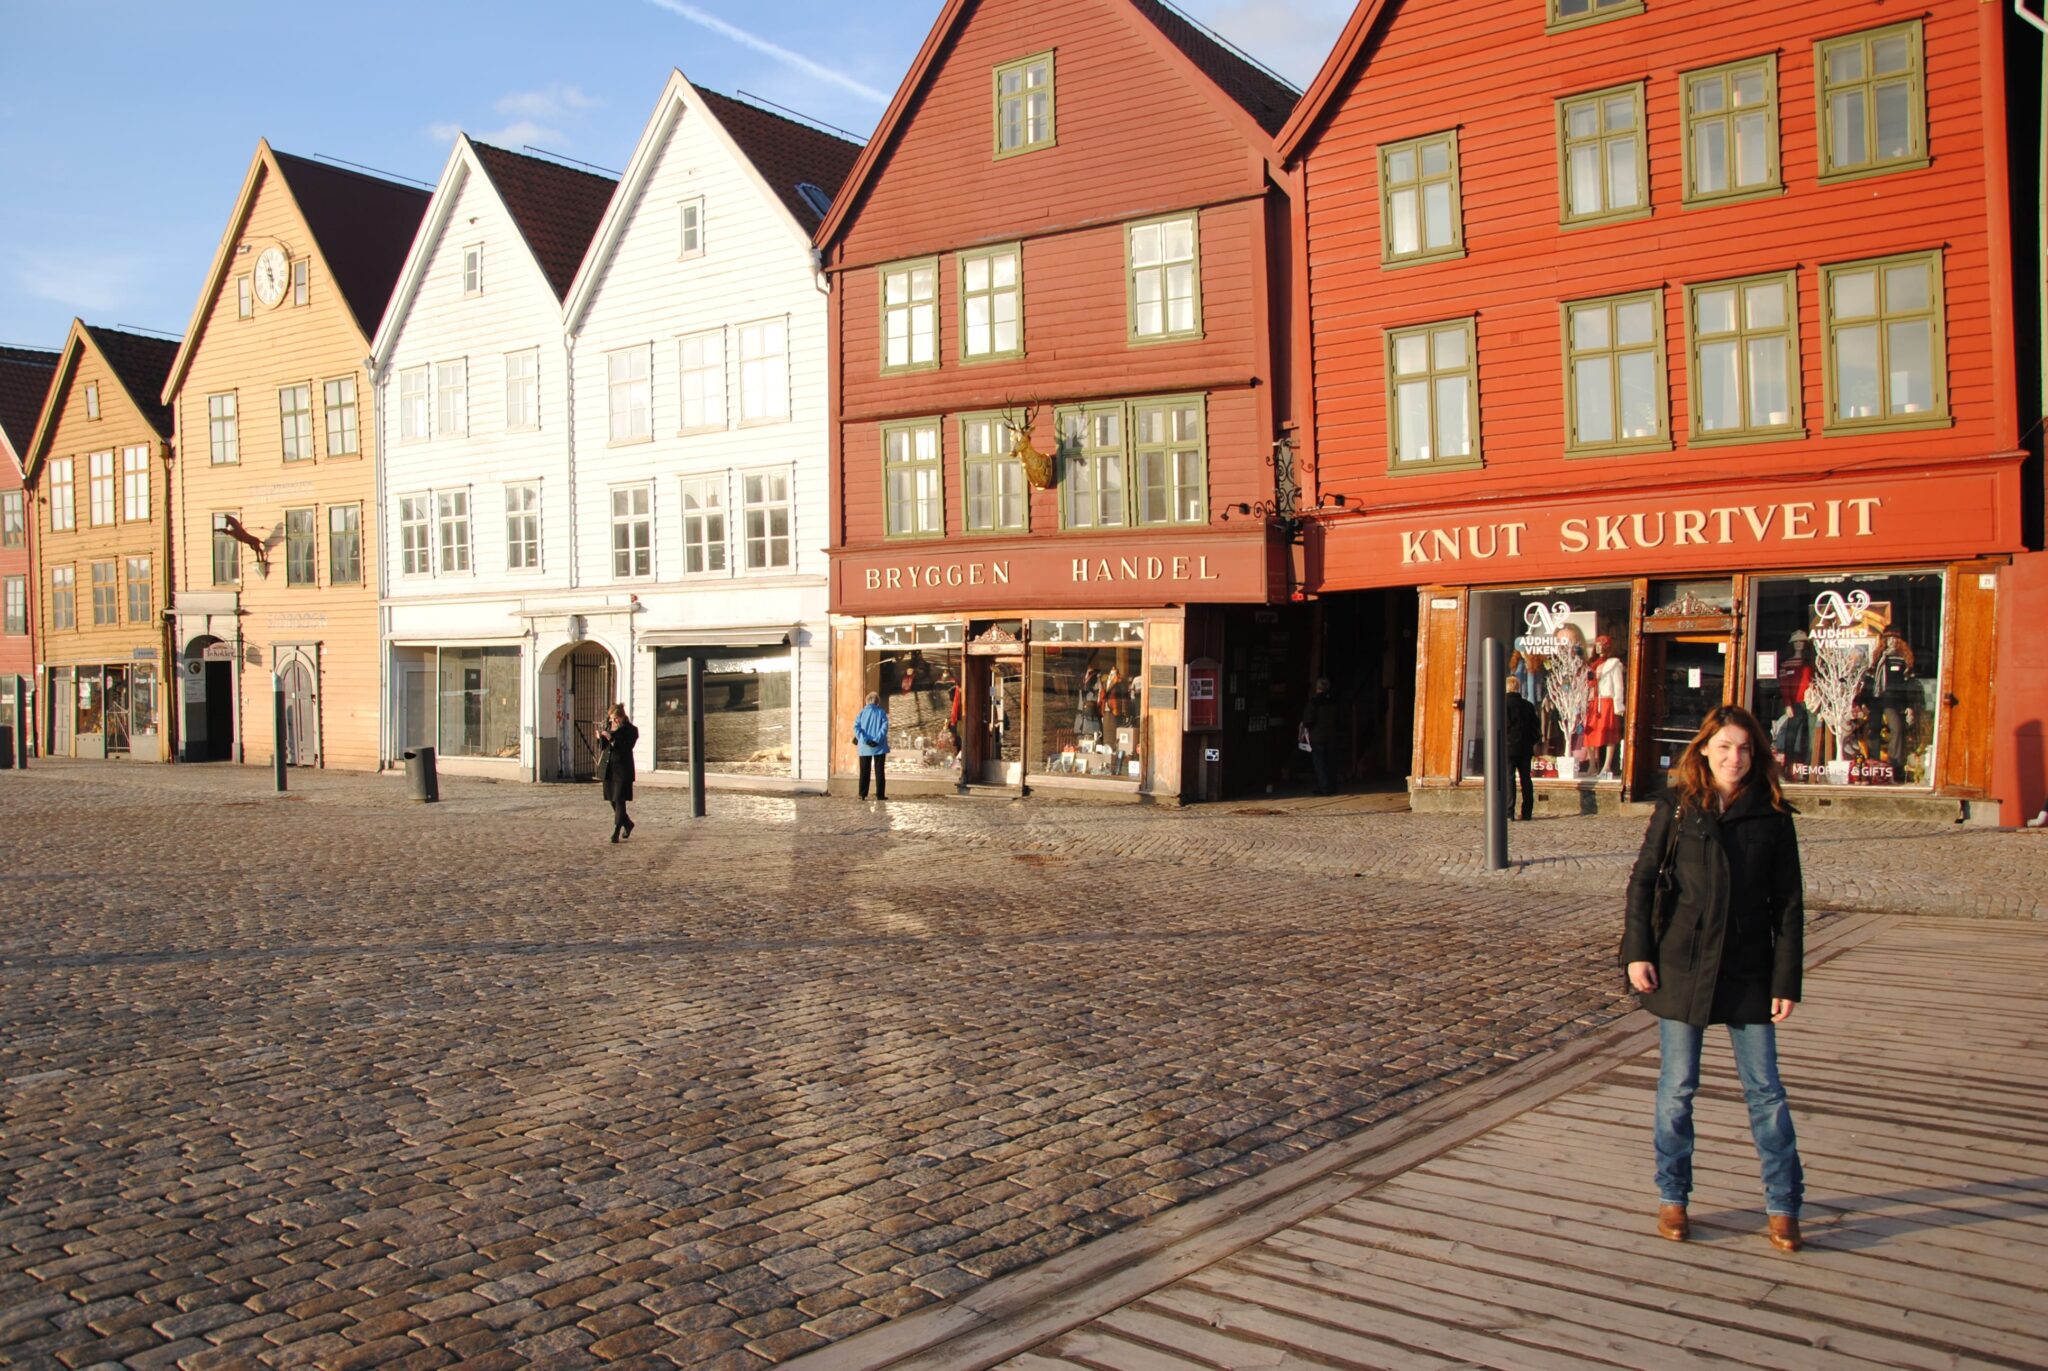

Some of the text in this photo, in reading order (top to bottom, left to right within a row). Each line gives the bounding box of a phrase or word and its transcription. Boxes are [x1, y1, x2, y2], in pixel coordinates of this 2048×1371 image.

[1401, 497, 1881, 565] KNUT SKURTVEIT
[865, 556, 1220, 590] BRYGGEN HANDEL
[1808, 629, 1868, 639] AUDHILD
[1519, 636, 1568, 646] AUDHILD
[1817, 639, 1855, 648] VIKEN
[1525, 646, 1557, 655] VIKEN
[1850, 766, 1860, 777] &
[1861, 766, 1893, 777] GIFTS
